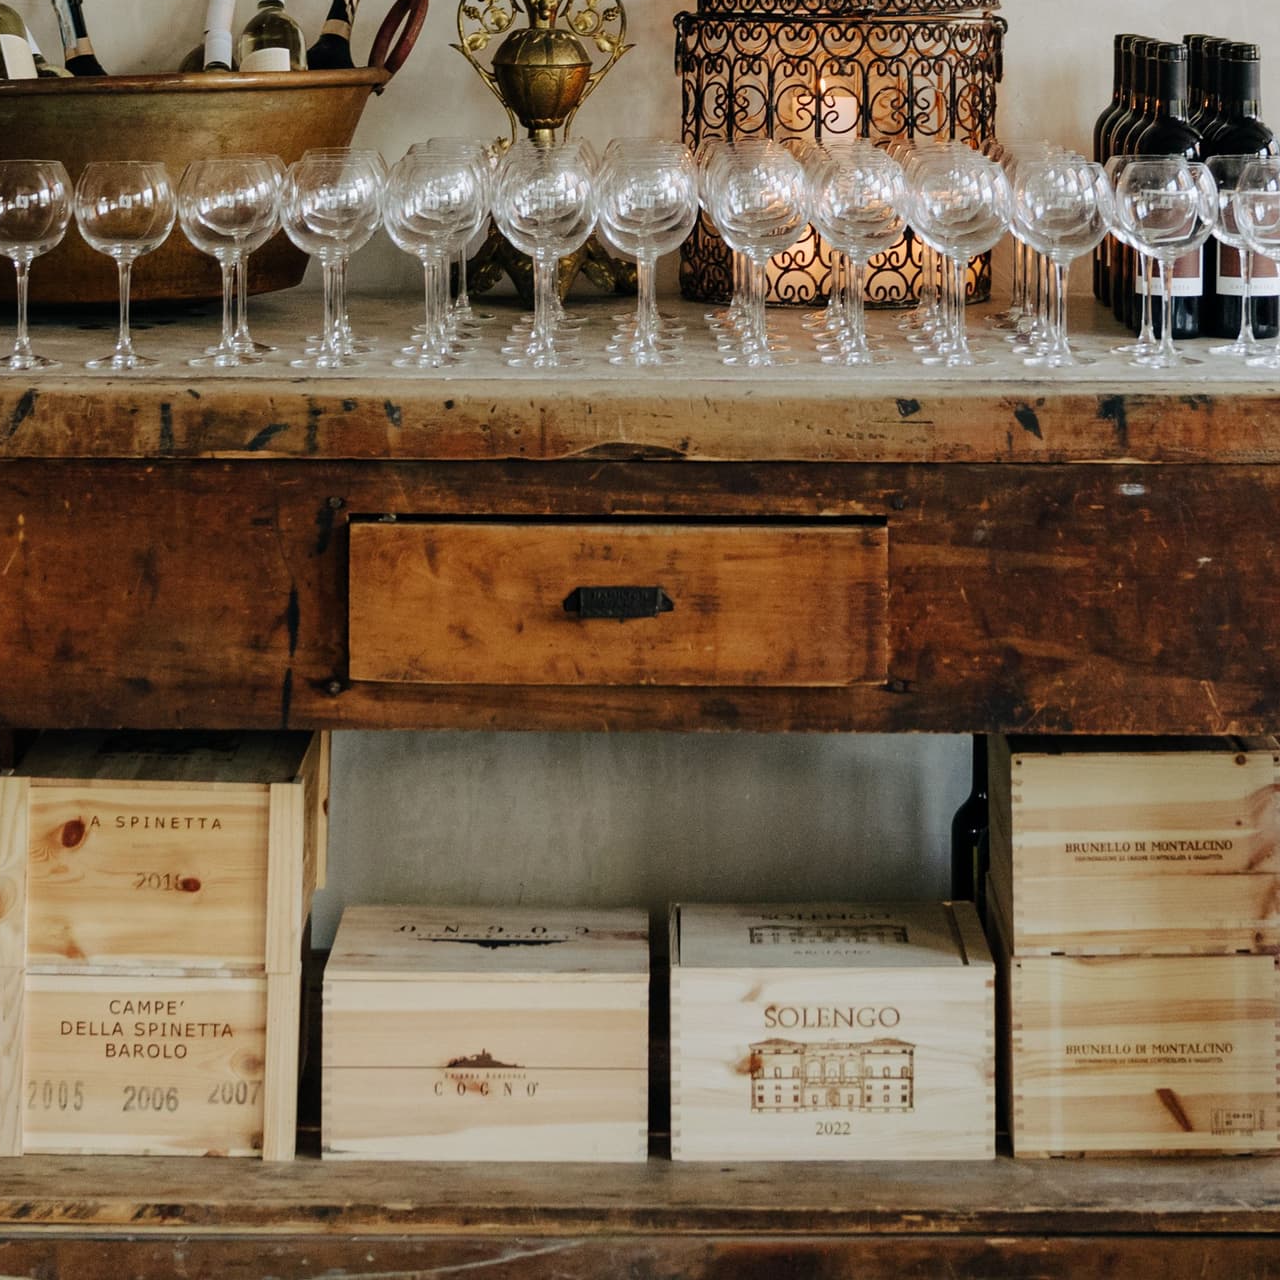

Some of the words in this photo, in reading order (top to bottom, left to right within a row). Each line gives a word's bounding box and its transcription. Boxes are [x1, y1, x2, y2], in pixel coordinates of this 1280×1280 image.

[78, 815, 101, 827] A
[115, 815, 222, 830] SPINETTA
[1065, 841, 1131, 853] BRUNELLO
[1135, 841, 1146, 852] DI
[1151, 839, 1233, 852] MONTALCINO
[763, 1005, 901, 1029] SOLENGO
[60, 1020, 124, 1036] DELLA
[133, 1021, 234, 1038] SPINETTA
[105, 1043, 188, 1060] BAROLO
[1065, 1043, 1131, 1055] BRUNELLO
[1135, 1043, 1147, 1054] DI
[1151, 1042, 1233, 1054] MONTALCINO
[27, 1079, 84, 1111] 2005
[122, 1085, 179, 1113] 2006
[207, 1079, 264, 1106] 2007
[815, 1120, 852, 1136] 2022
